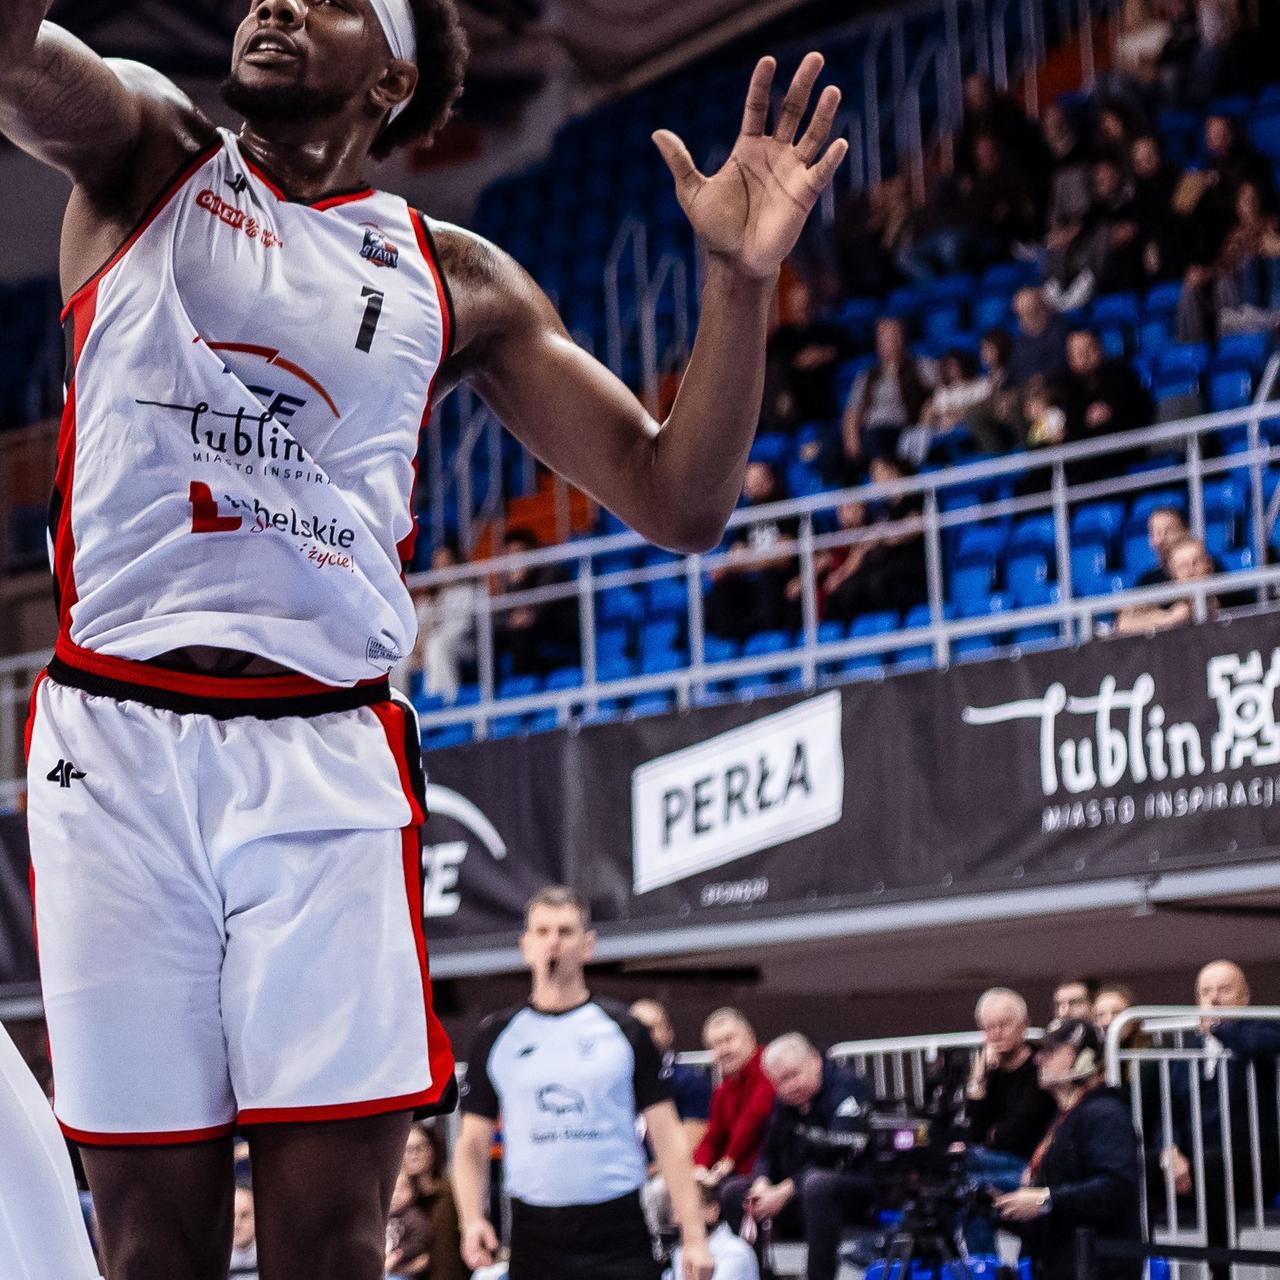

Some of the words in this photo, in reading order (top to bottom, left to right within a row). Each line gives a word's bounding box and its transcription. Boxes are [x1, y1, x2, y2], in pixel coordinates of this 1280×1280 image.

[354, 285, 385, 353] 1
[661, 738, 813, 849] PERŁA
[1042, 795, 1136, 833] MIASTO
